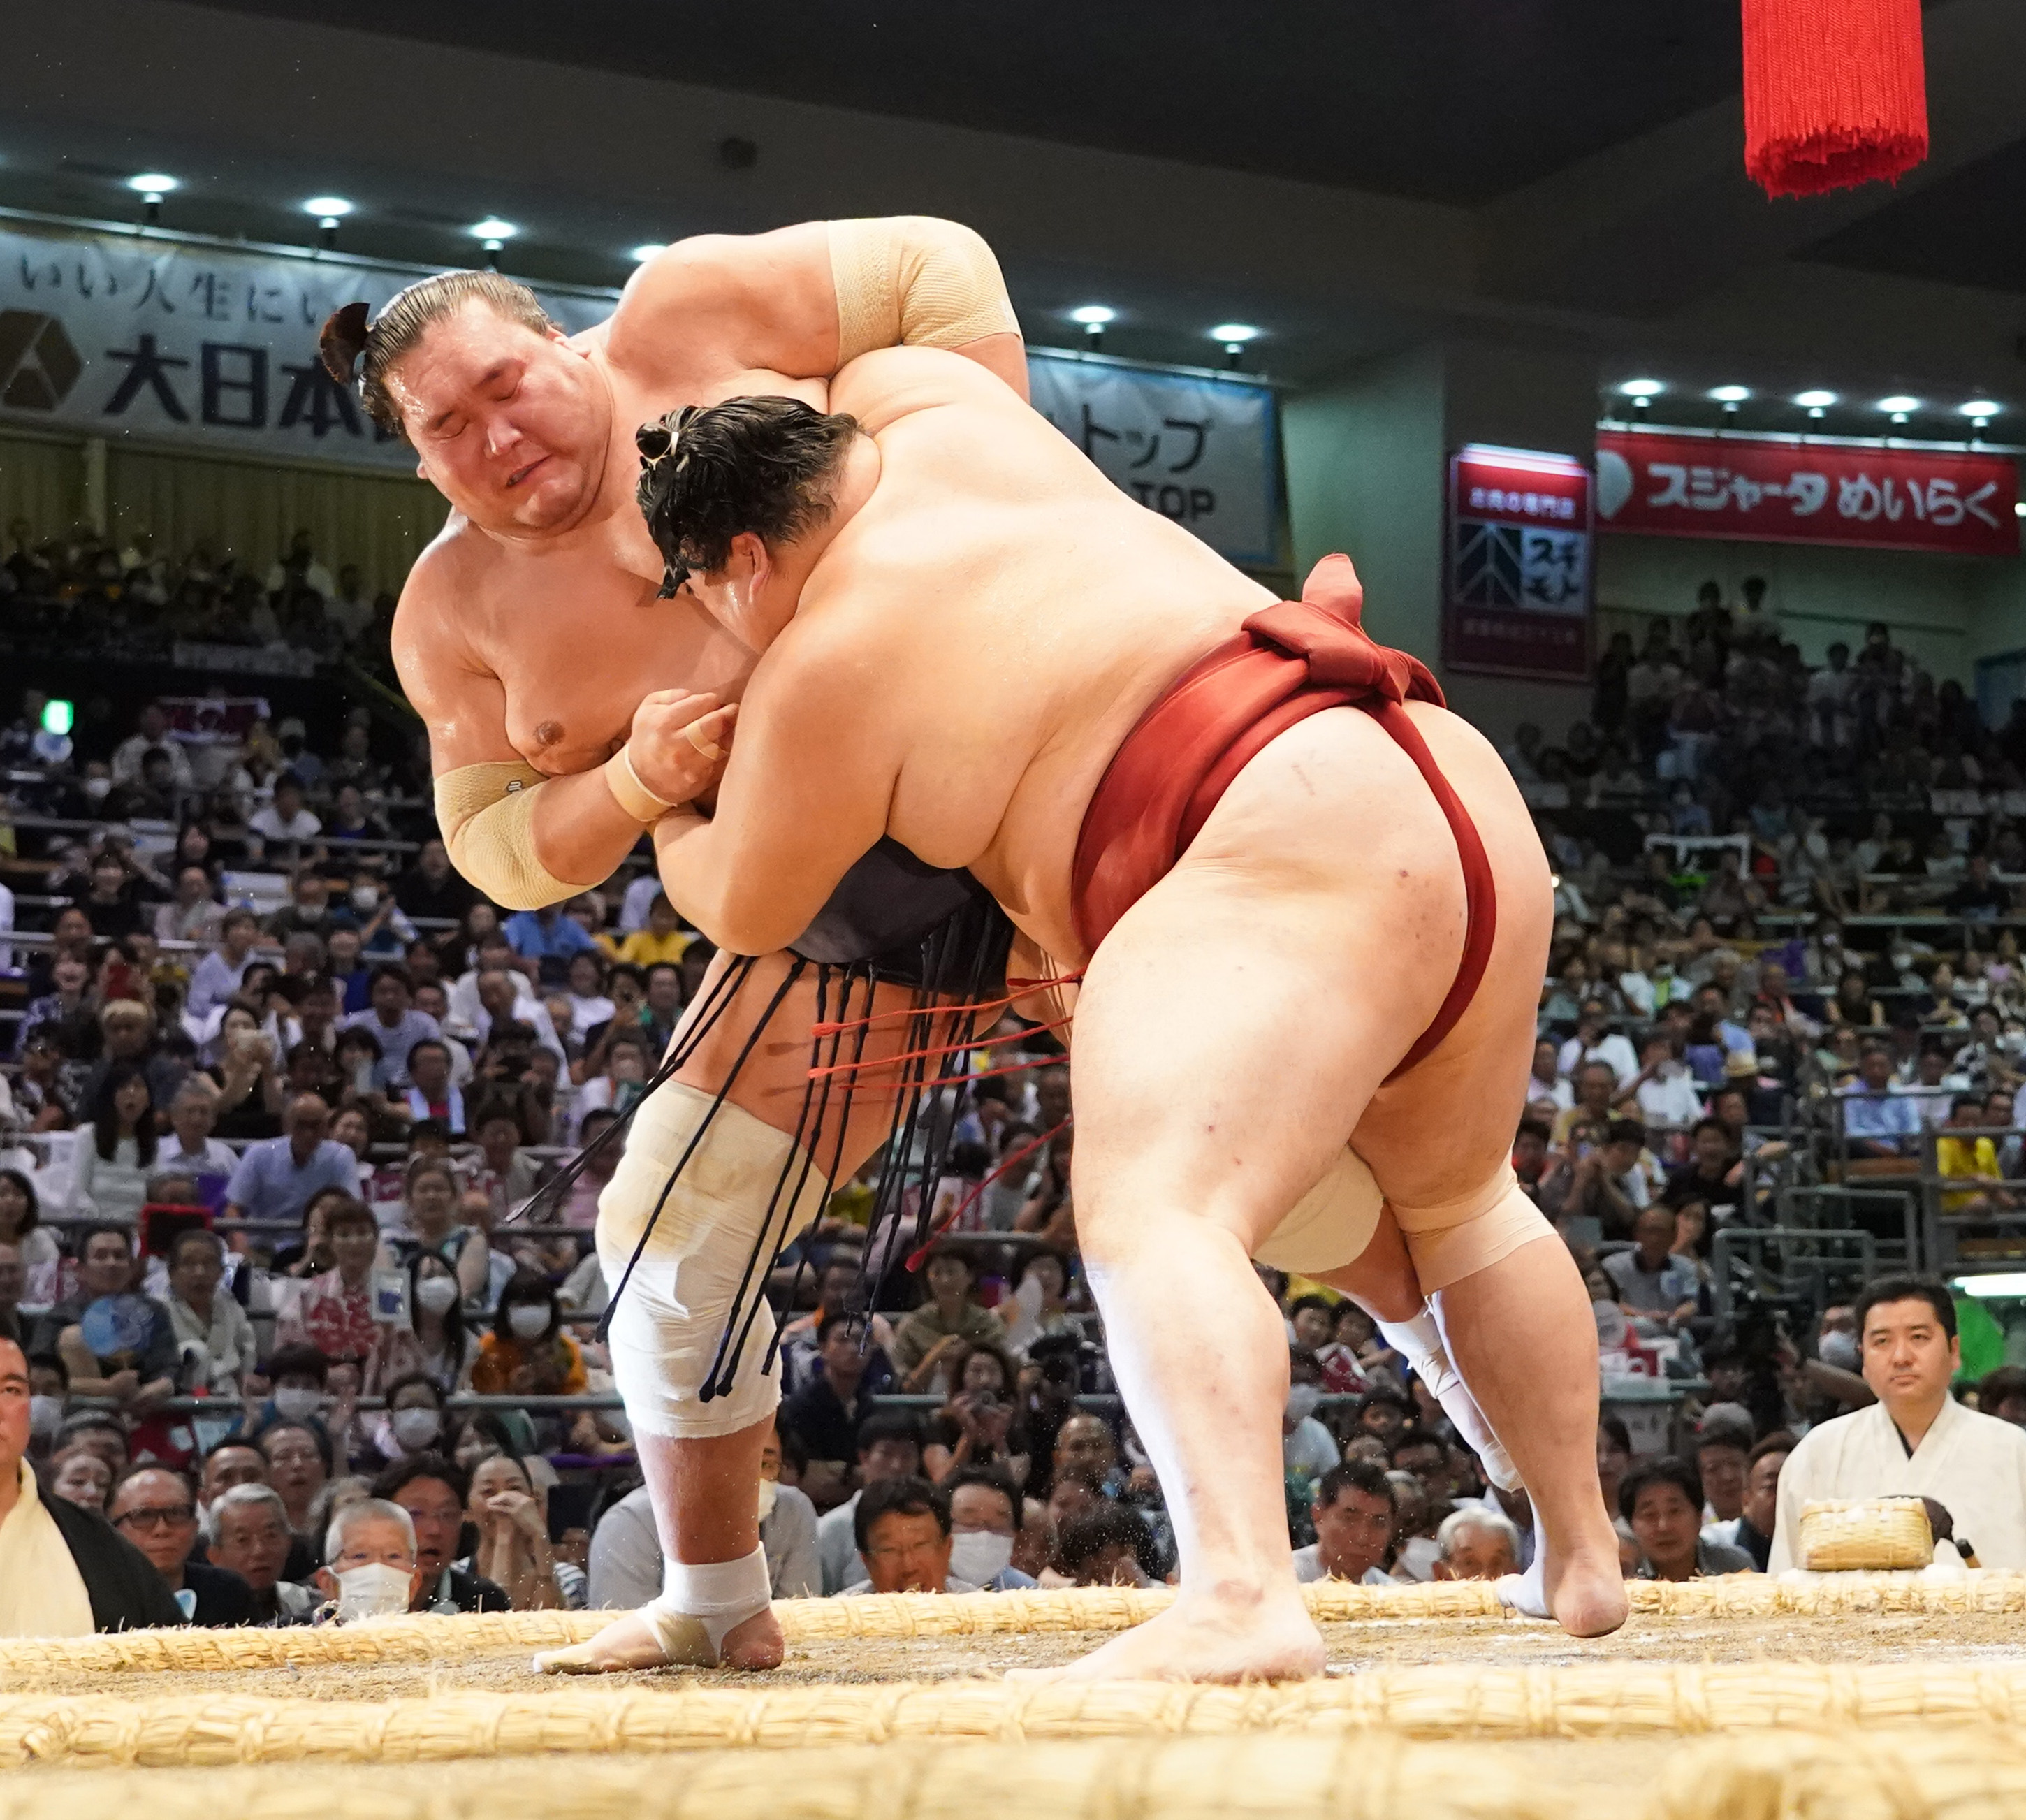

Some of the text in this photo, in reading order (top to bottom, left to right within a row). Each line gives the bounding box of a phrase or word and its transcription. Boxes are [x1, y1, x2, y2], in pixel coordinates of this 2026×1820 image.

[103, 332, 400, 443] 大日本
[1045, 402, 1216, 474] トップ
[1648, 462, 2000, 530] スジャータ めいらく
